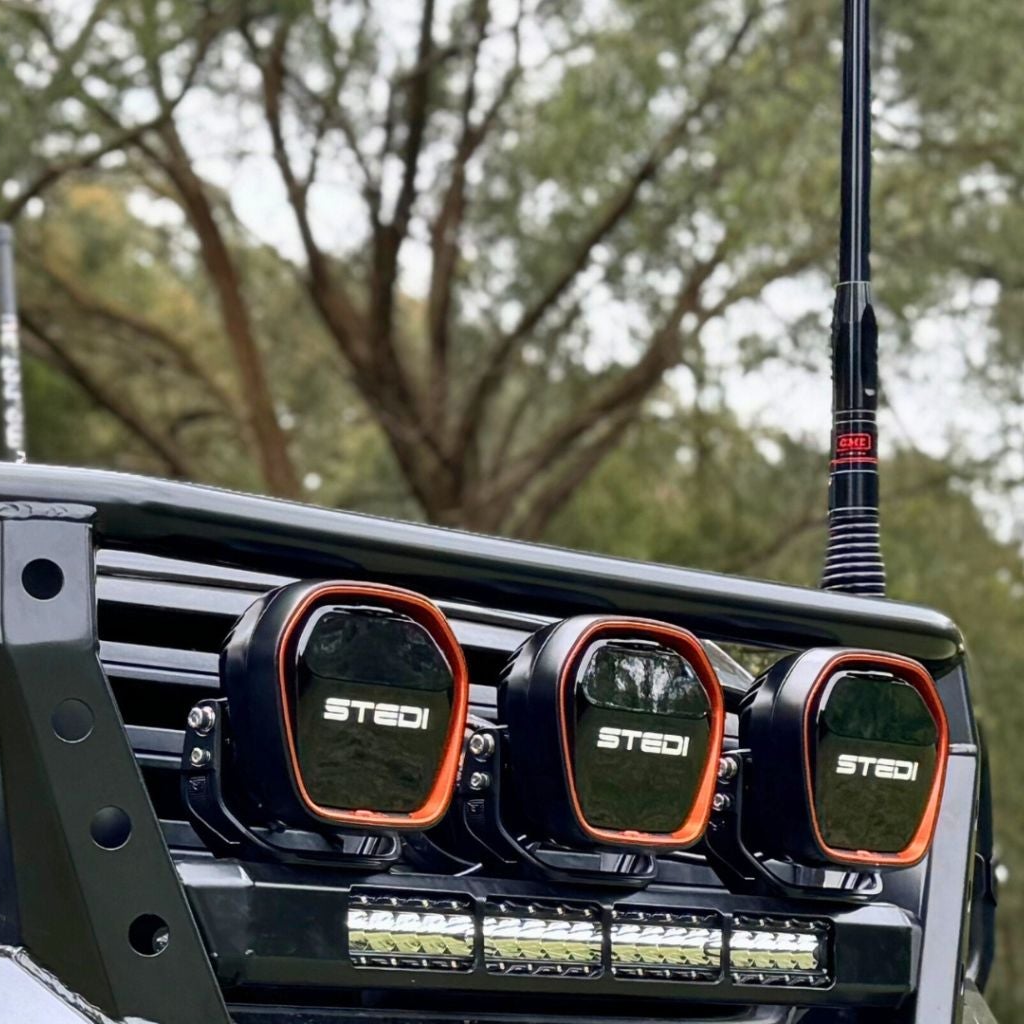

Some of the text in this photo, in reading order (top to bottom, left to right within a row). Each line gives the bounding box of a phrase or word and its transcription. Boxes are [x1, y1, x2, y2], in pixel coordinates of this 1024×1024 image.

[323, 697, 430, 730] STEDI
[596, 726, 690, 757] STEDI
[835, 754, 919, 781] STEDI
